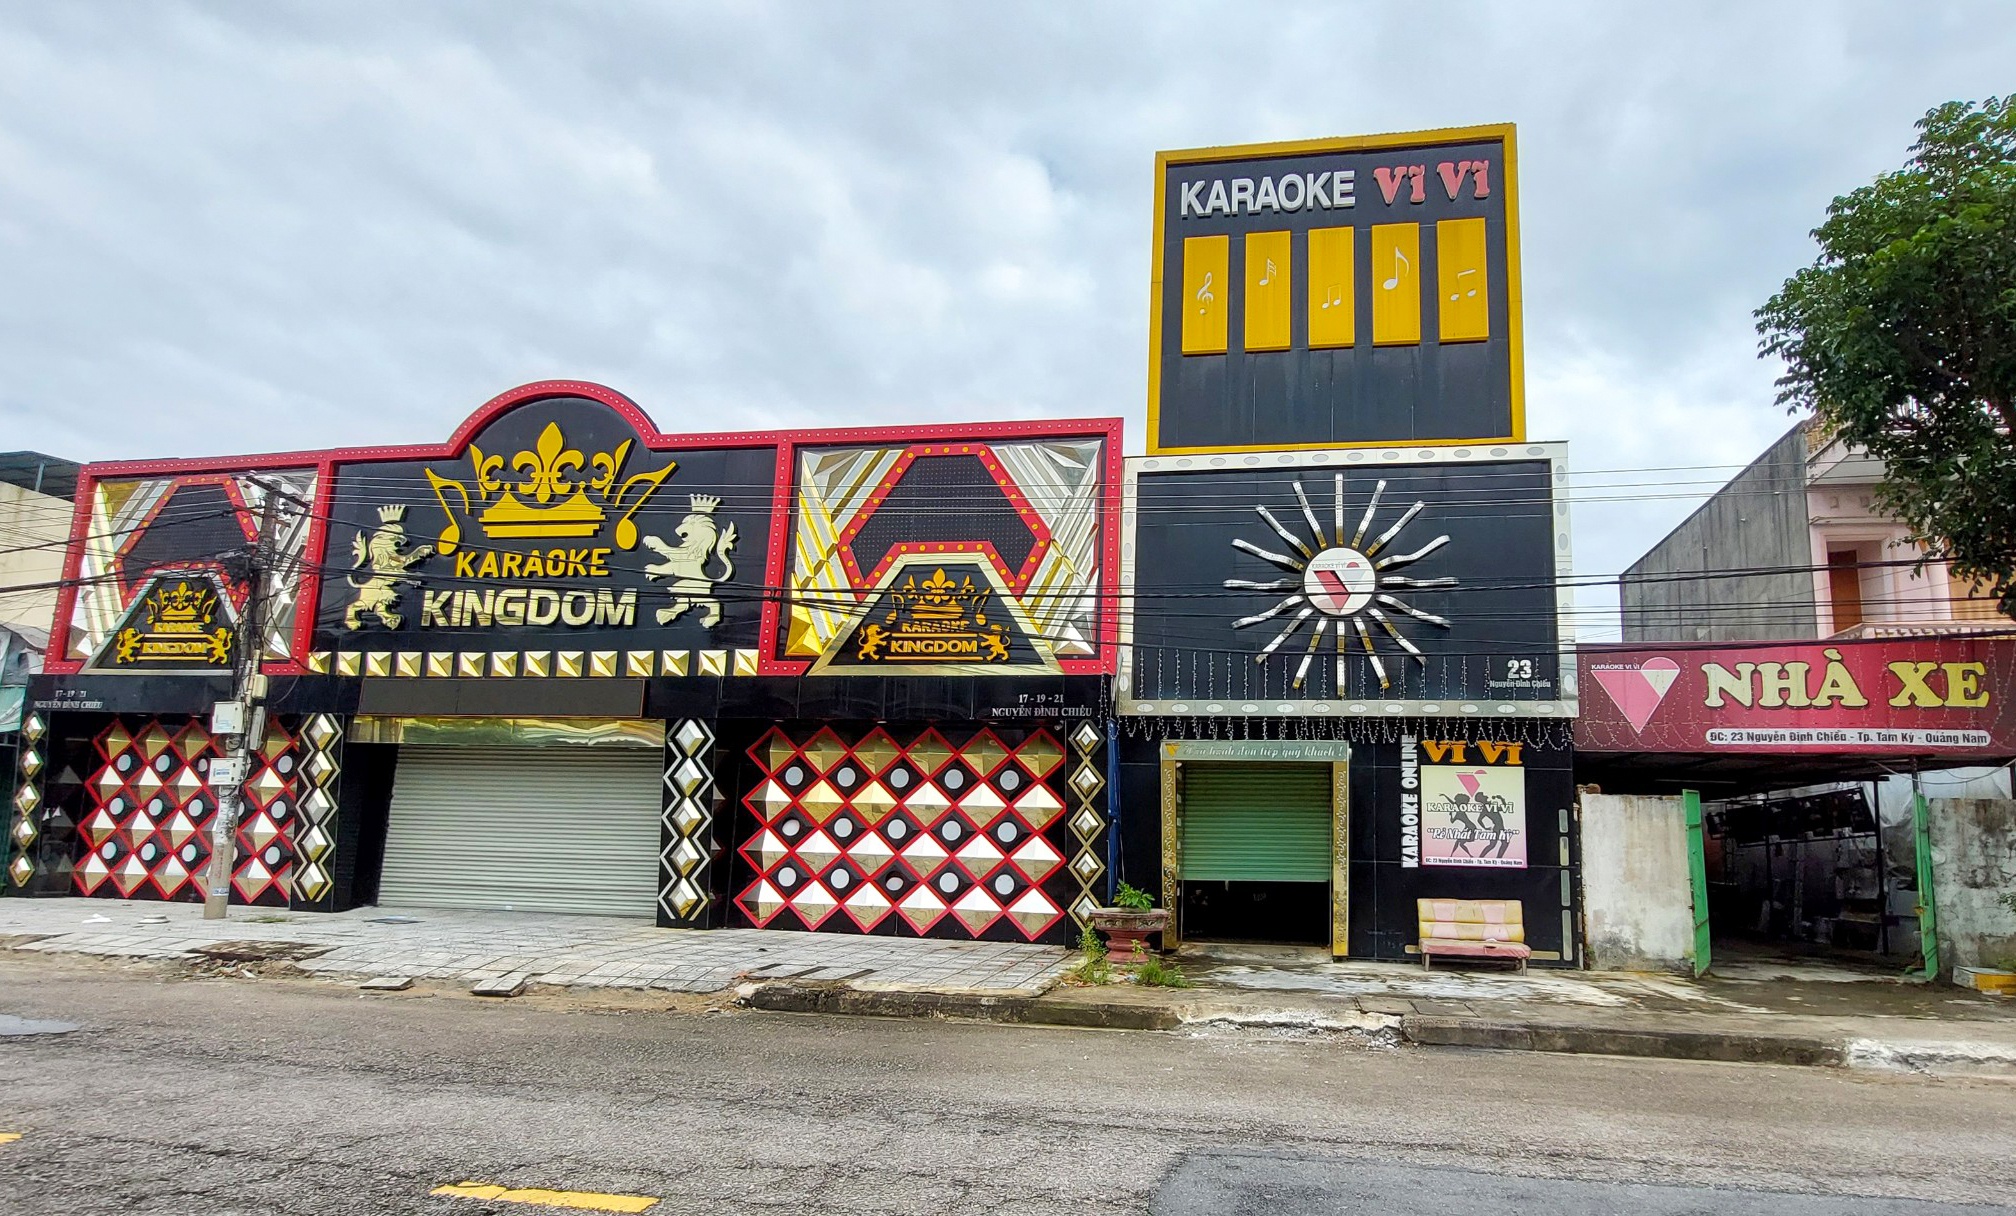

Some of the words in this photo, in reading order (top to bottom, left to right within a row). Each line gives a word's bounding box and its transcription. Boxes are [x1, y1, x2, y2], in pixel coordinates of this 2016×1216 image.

[1180, 169, 1356, 217] KARAOKE
[456, 548, 613, 578] KARAOKE
[421, 588, 638, 627] KINGDOM
[142, 642, 208, 654] KINGDOM
[890, 640, 978, 653] KINGDOM
[1507, 659, 1532, 679] 23
[1702, 648, 1869, 709] NHÀ
[1887, 661, 1991, 709] XE
[1018, 694, 1028, 703] 17
[1036, 694, 1046, 703] 19
[1054, 694, 1064, 703] 21
[1710, 731, 1728, 742] ĐC:
[1730, 731, 1744, 741] 23
[1857, 731, 1873, 743] Tp.
[1876, 732, 1898, 742] Tam
[1961, 733, 1987, 744] Nam
[1401, 734, 1418, 789] ONLINE
[1427, 803, 1483, 812] KARAOKE
[1401, 793, 1419, 868] KARAOKE
[1474, 829, 1497, 841] Tam
